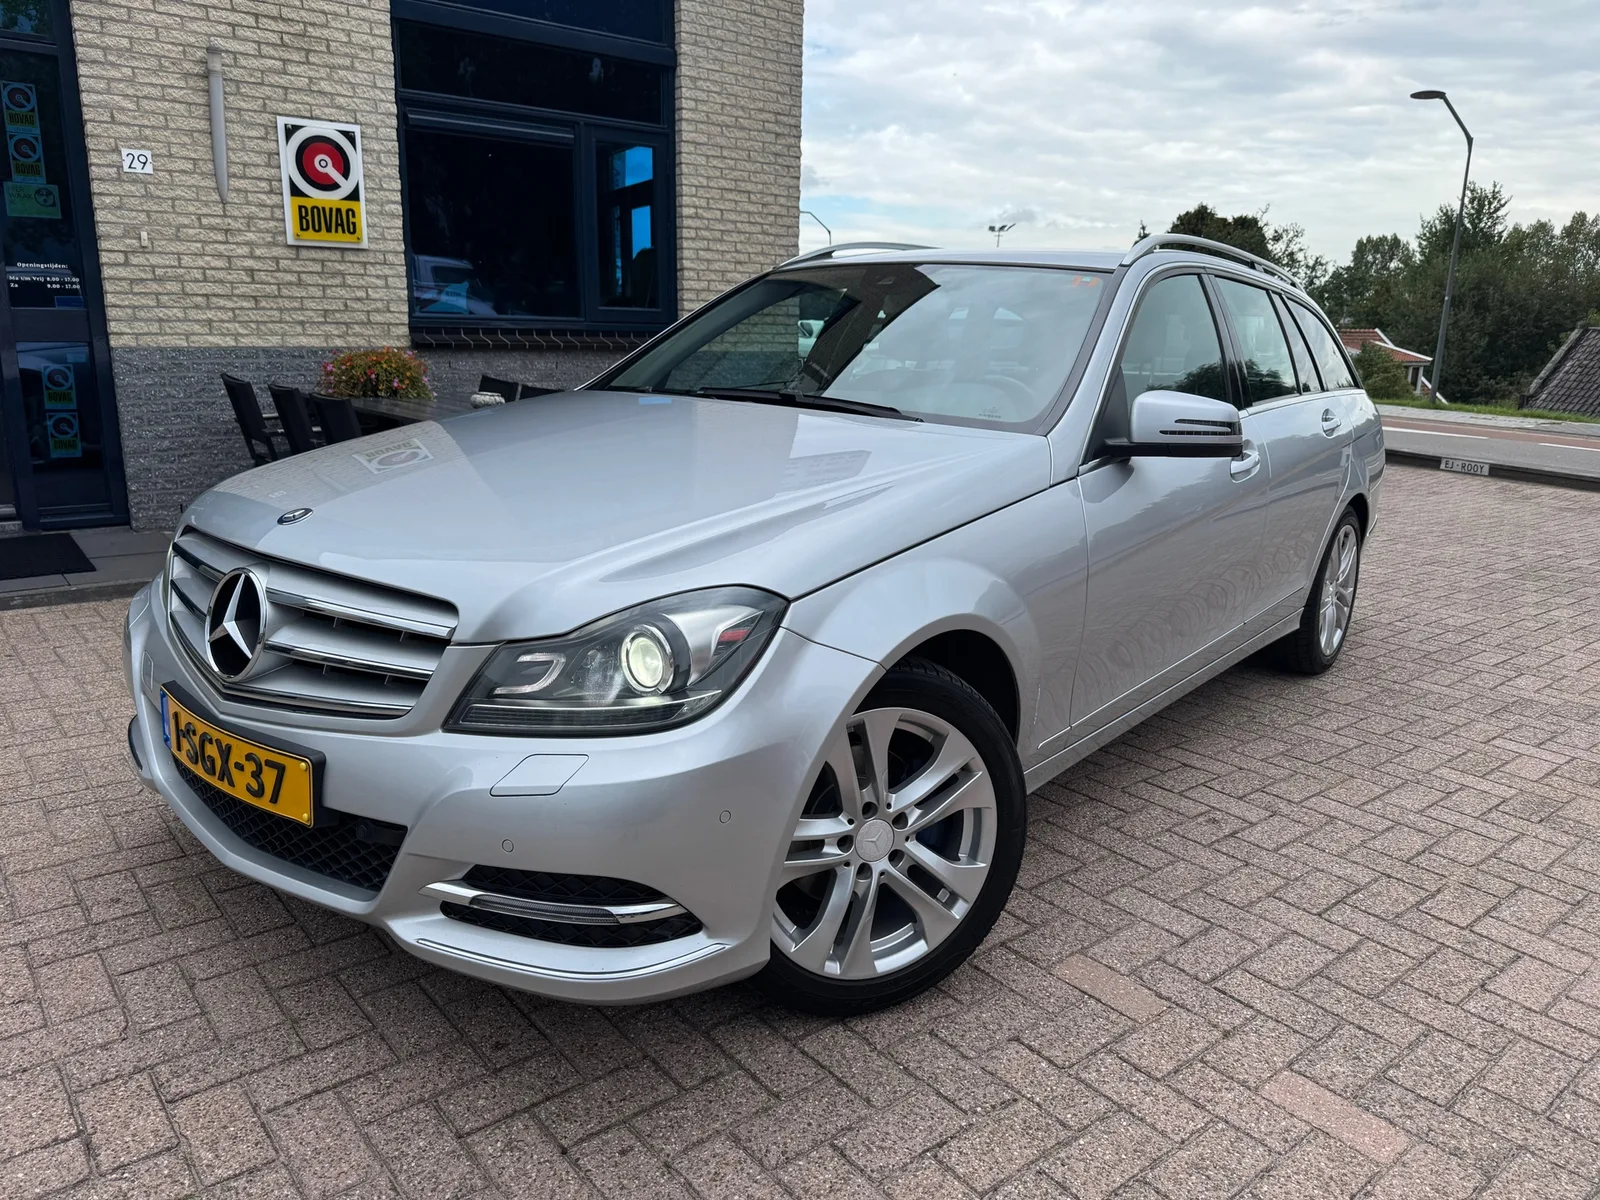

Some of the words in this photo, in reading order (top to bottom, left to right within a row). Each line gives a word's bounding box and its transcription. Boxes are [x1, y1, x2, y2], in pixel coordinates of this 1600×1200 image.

[8, 112, 35, 125] BOVAG
[126, 152, 149, 171] 29
[297, 204, 358, 235] BOVAG
[172, 711, 287, 804] 1-SGX-37
